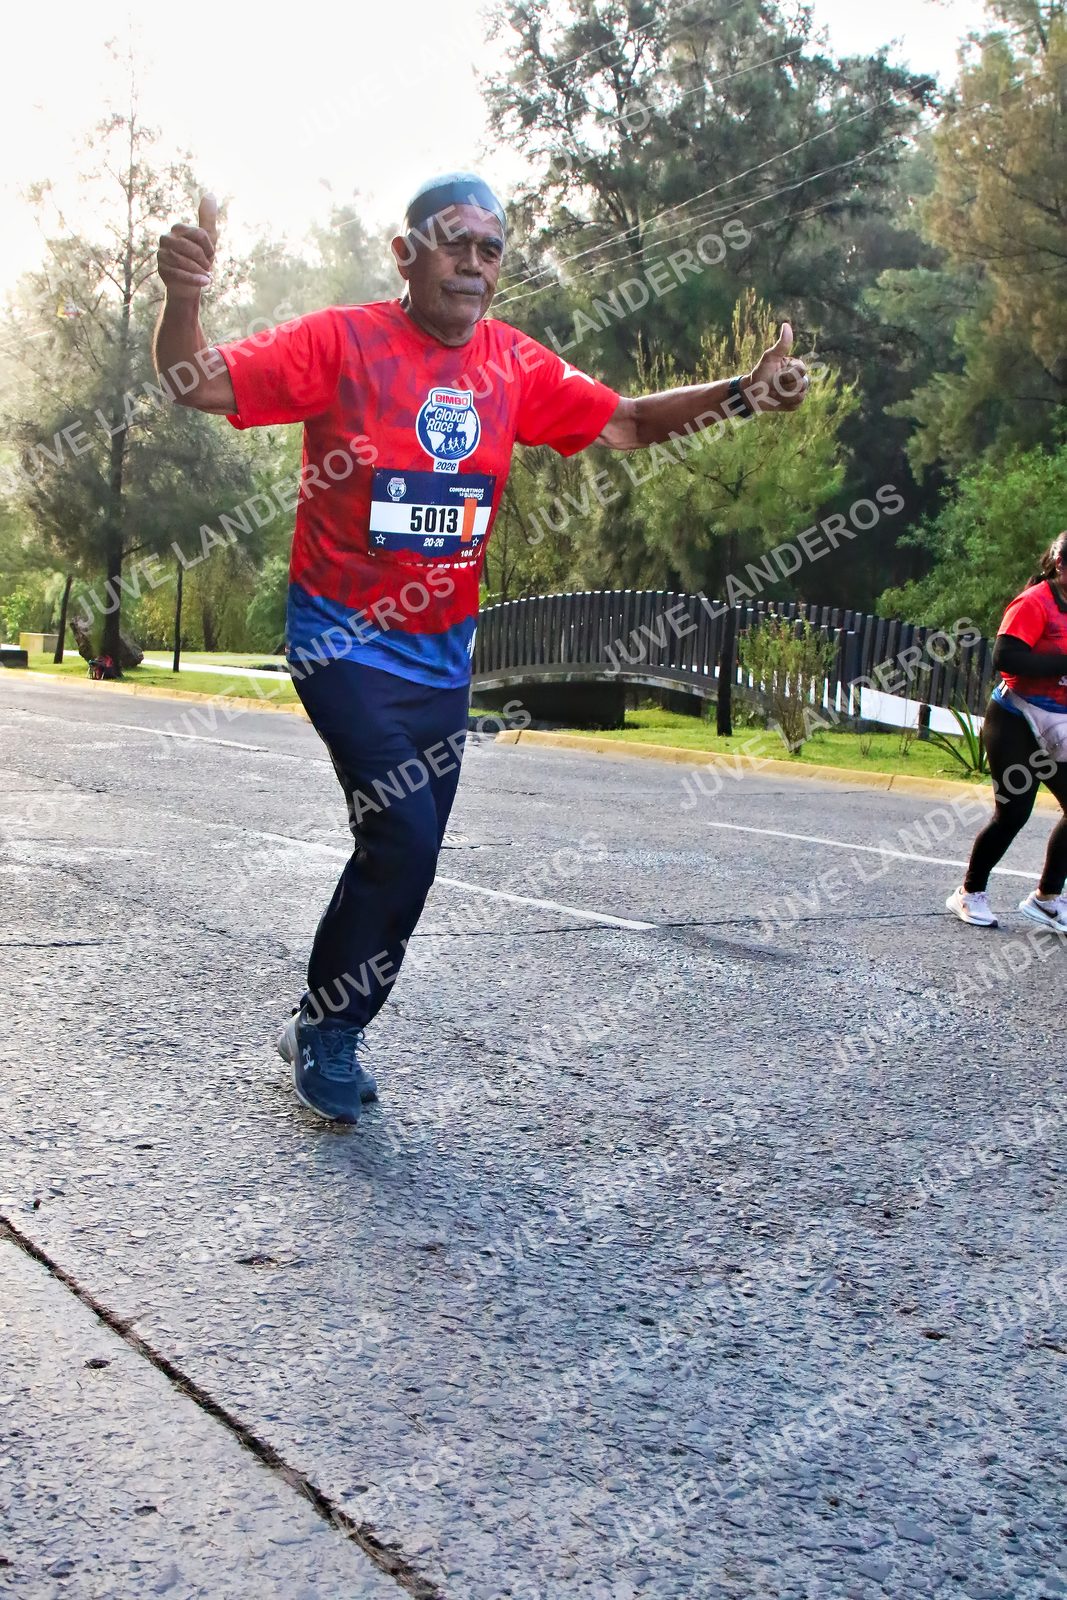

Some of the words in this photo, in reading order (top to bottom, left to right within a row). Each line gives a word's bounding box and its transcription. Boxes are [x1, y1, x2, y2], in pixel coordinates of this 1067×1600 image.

[435, 394, 469, 406] BIMBO
[434, 408, 468, 424] Global
[426, 418, 454, 433] Race
[435, 461, 458, 472] 2026
[410, 506, 458, 533] 5013
